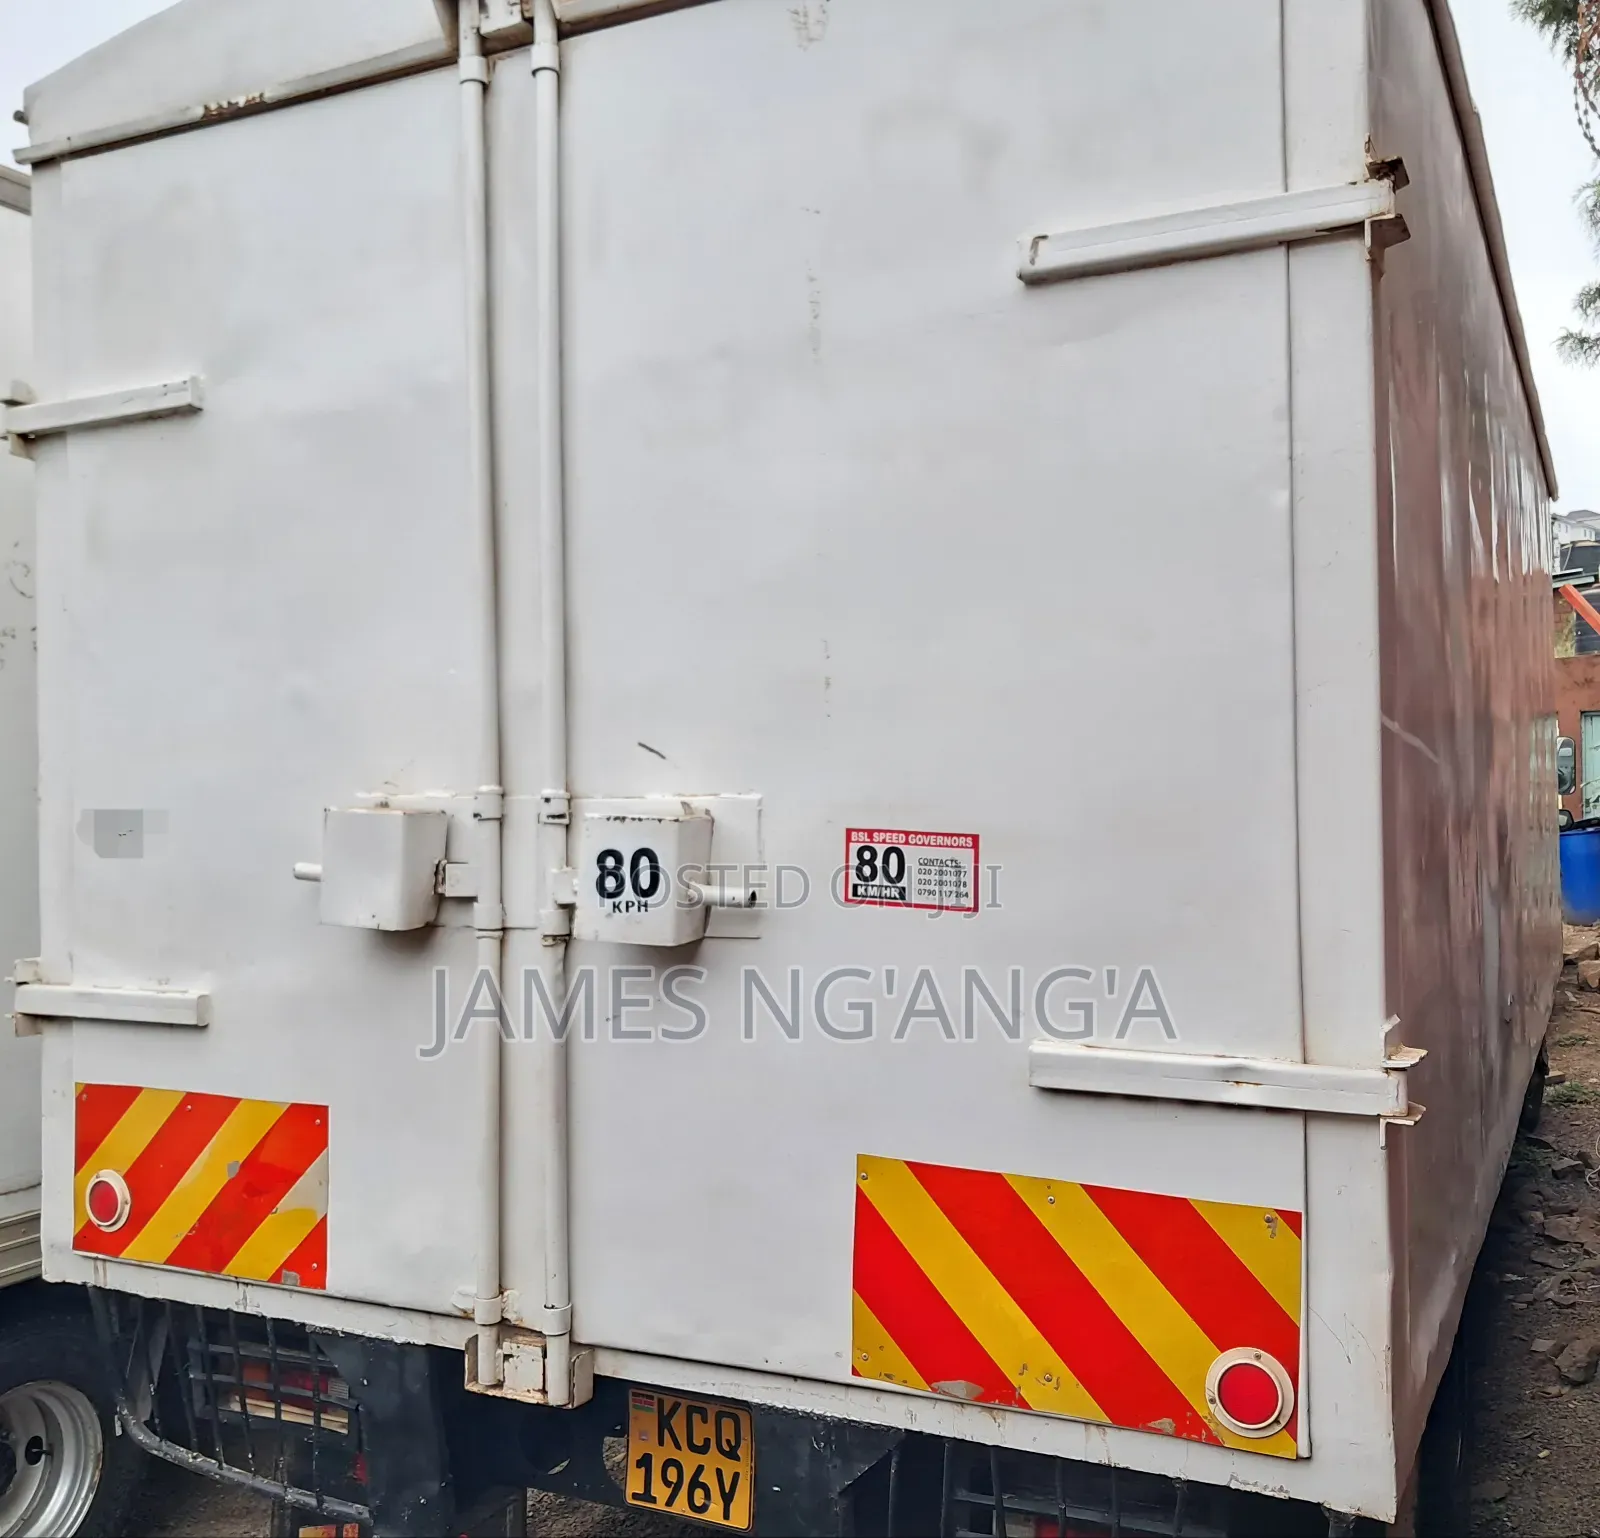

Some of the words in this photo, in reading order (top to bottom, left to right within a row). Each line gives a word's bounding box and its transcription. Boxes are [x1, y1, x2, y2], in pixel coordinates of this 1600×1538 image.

[851, 831, 871, 842] BSL
[873, 833, 905, 844] SPEED
[908, 835, 973, 847] GOVERNORS
[855, 845, 906, 884] 80
[595, 848, 660, 899] 80
[917, 868, 932, 876] 020
[933, 869, 967, 878] 2001077
[917, 878, 932, 886] 020
[857, 885, 900, 899] KM/HR
[917, 888, 937, 897] 0790
[612, 900, 649, 913] KPH
[657, 1398, 741, 1462] KCQ
[631, 1453, 740, 1520] 196Y
